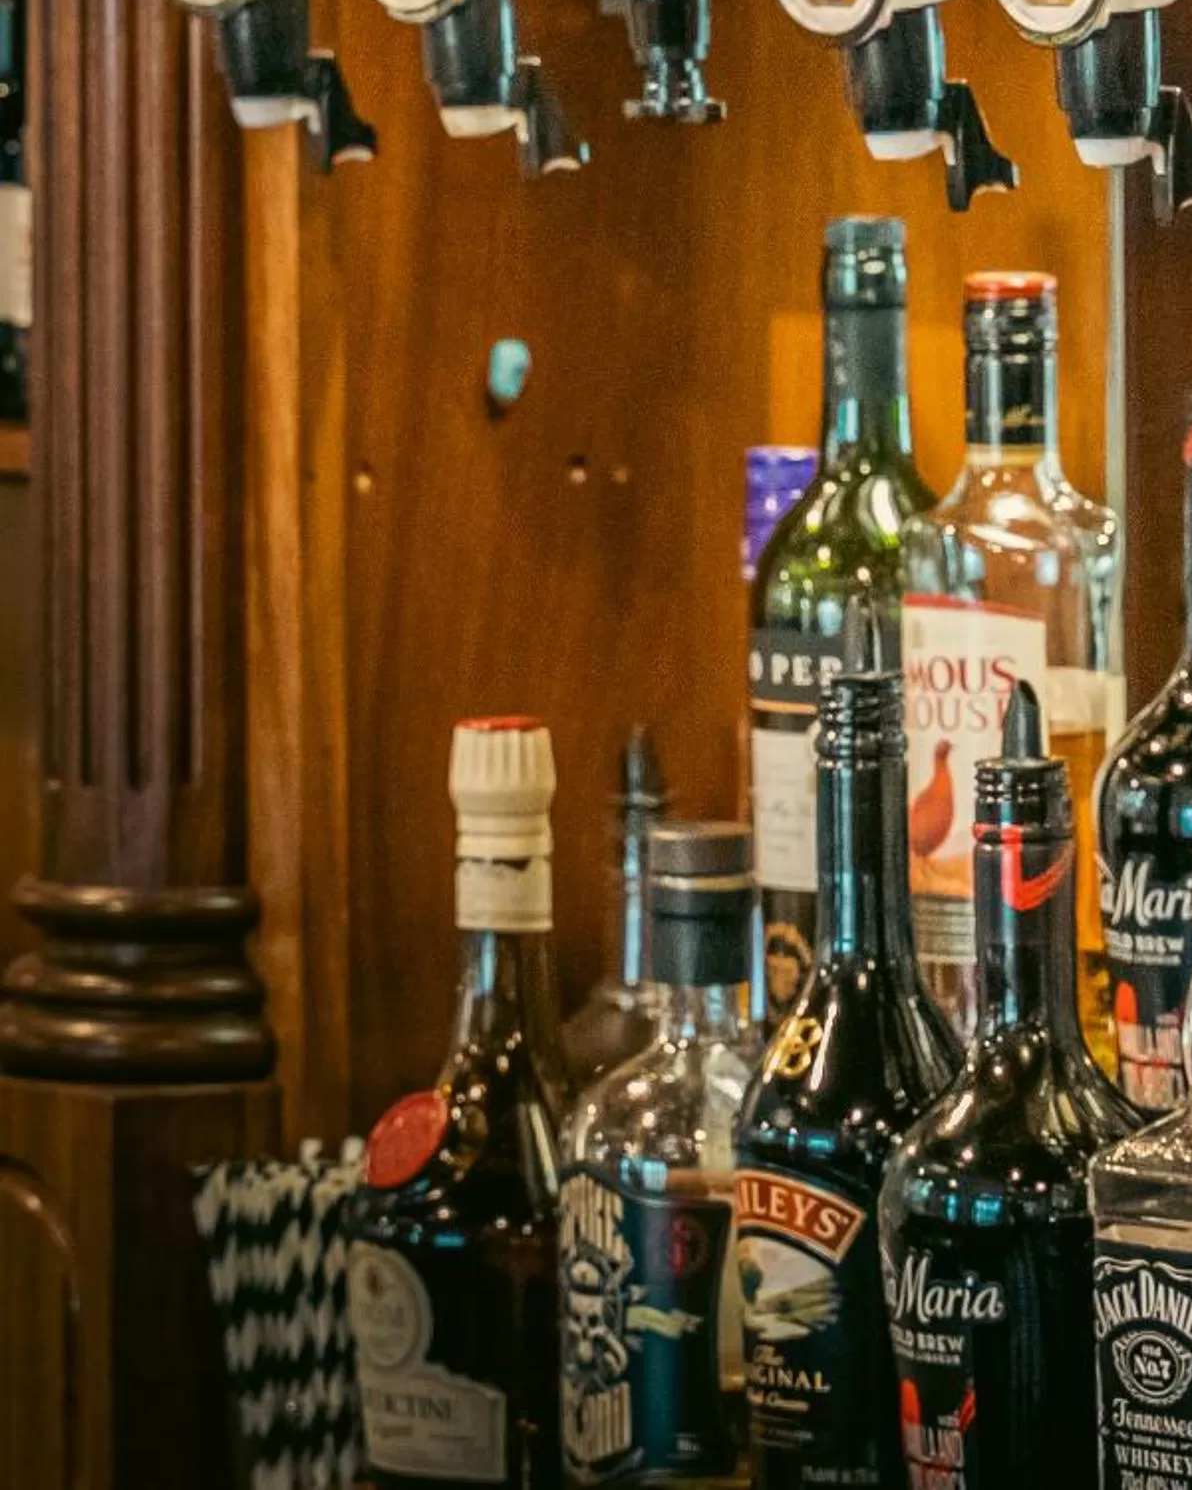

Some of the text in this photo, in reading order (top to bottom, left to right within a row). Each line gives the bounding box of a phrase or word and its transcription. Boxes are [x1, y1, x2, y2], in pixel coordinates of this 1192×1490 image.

[895, 1255, 1003, 1324] Maria
[1092, 1280, 1141, 1339] JACK
[916, 1331, 965, 1353] BREW
